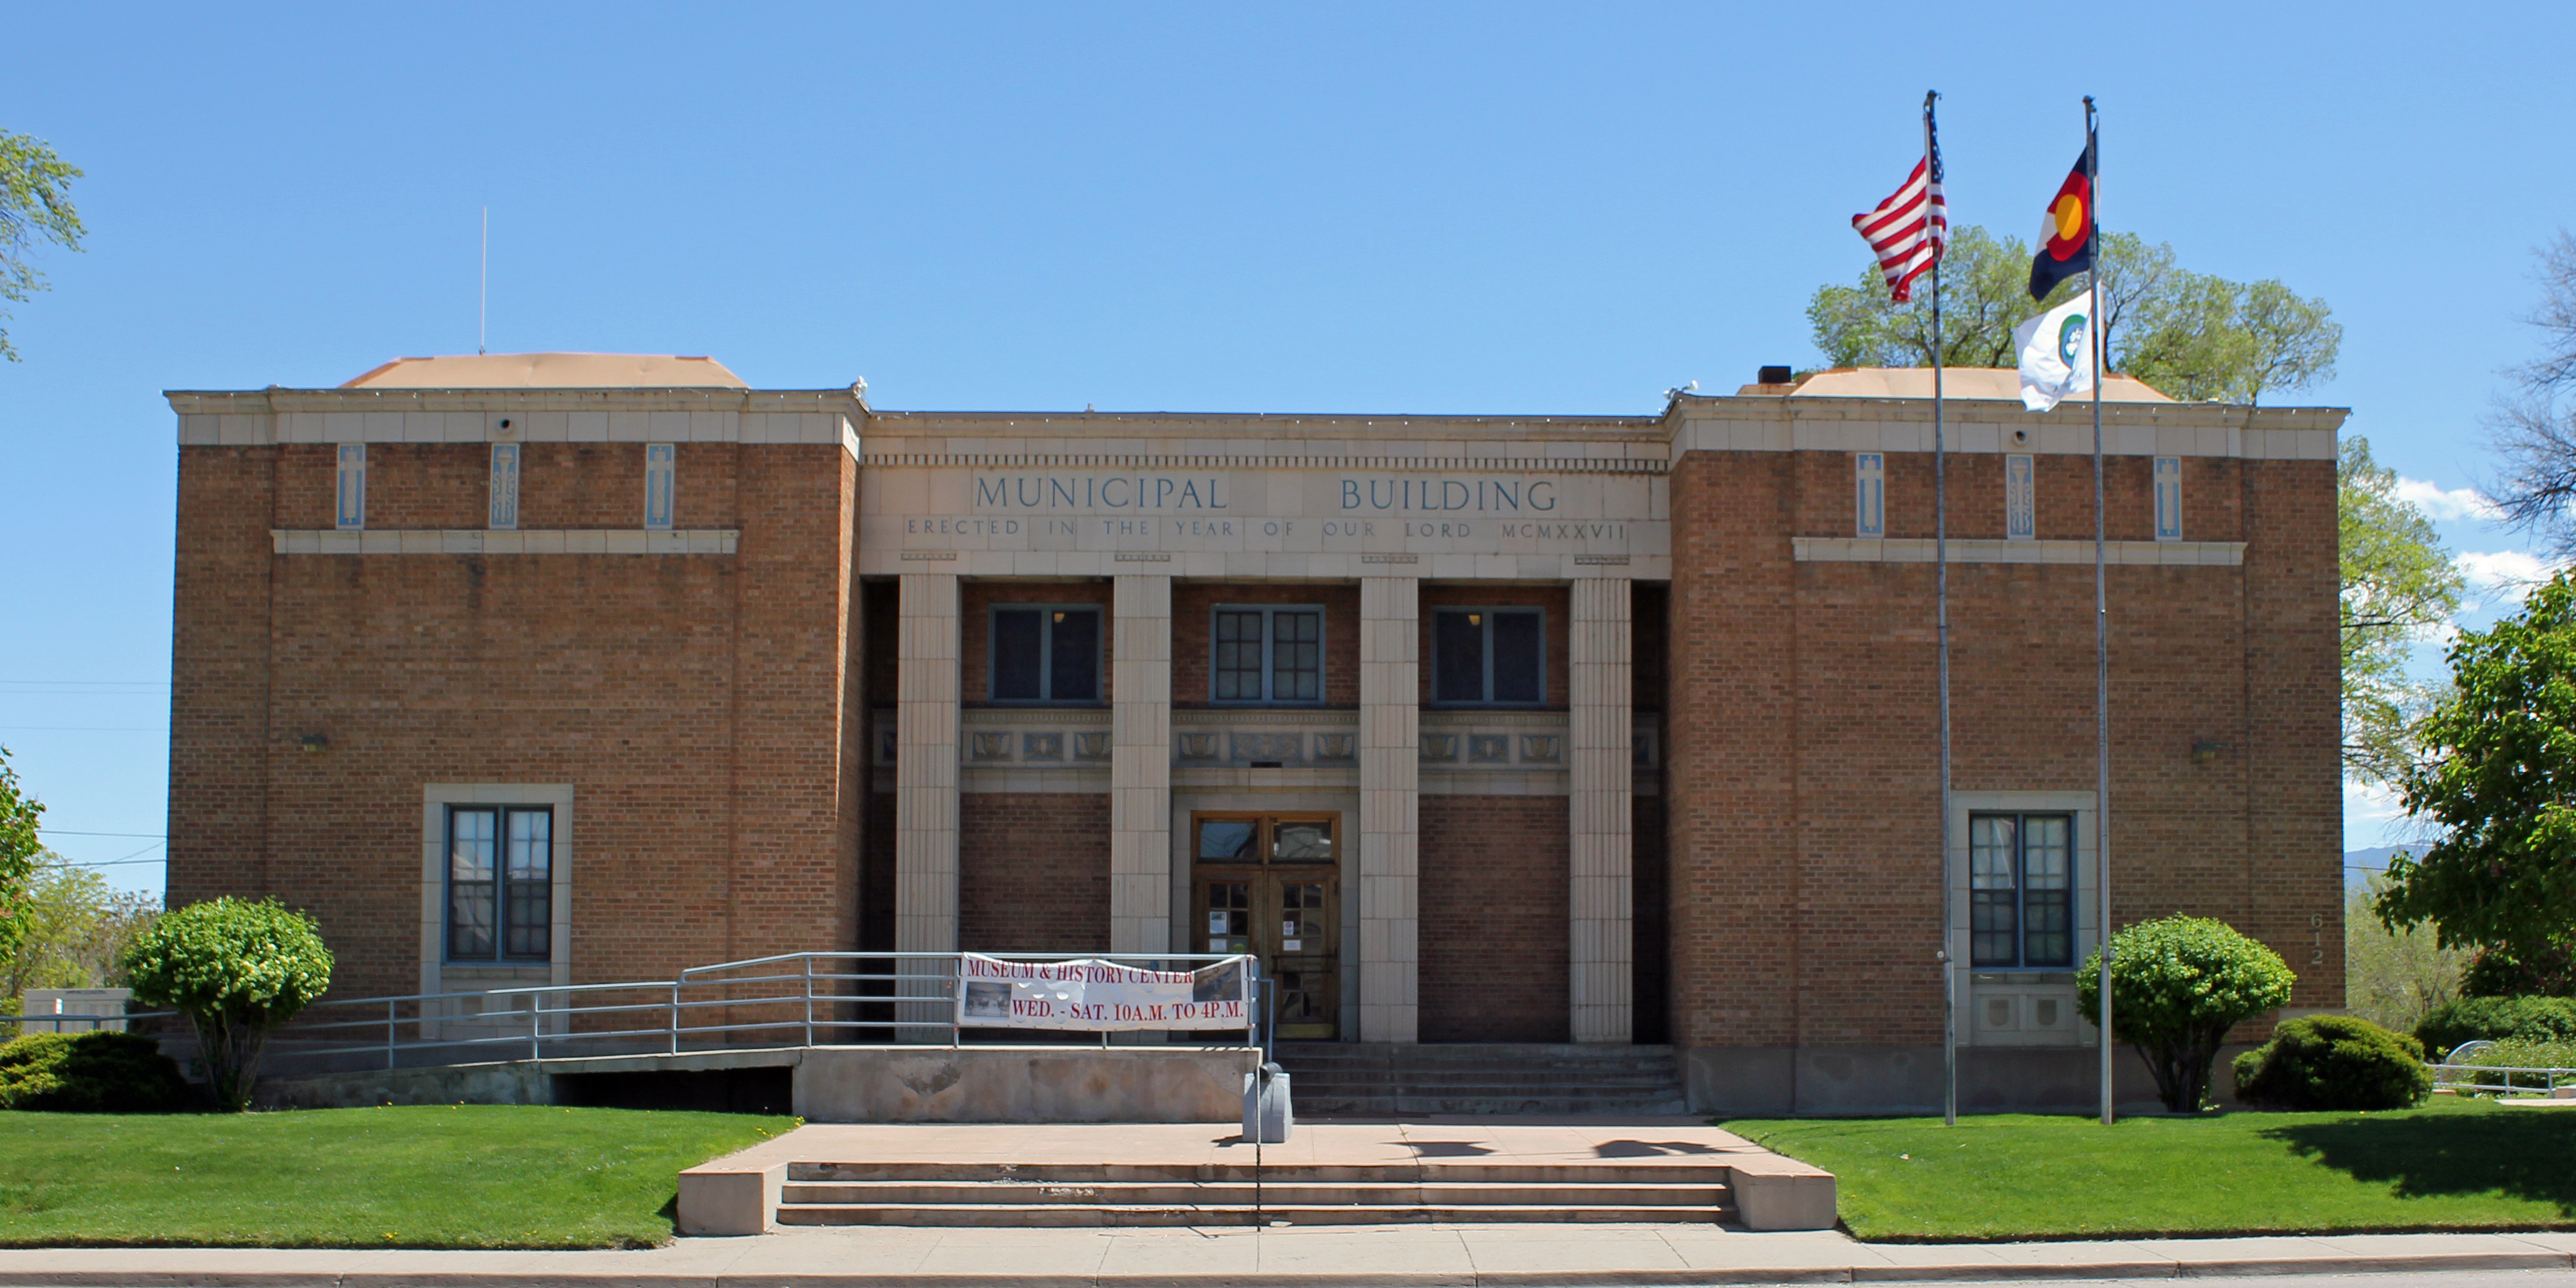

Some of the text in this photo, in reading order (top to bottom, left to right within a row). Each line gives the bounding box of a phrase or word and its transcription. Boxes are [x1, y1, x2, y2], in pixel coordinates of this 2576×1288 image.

[976, 478, 1556, 511] MUNICIPAL BUILDING
[908, 519, 1625, 539] ERECTED IN THE YEAR OF OUR LORD MCMXXVII
[2310, 913, 2323, 965] 612
[967, 959, 1193, 984] MUSEUM & HISTORY CENTER
[1012, 999, 1055, 1018] WED.
[1070, 1002, 1108, 1021] SAT.
[1114, 1003, 1168, 1021] 10A.M.
[1172, 1002, 1196, 1019] TO
[1200, 1001, 1244, 1019] 4P.M.
